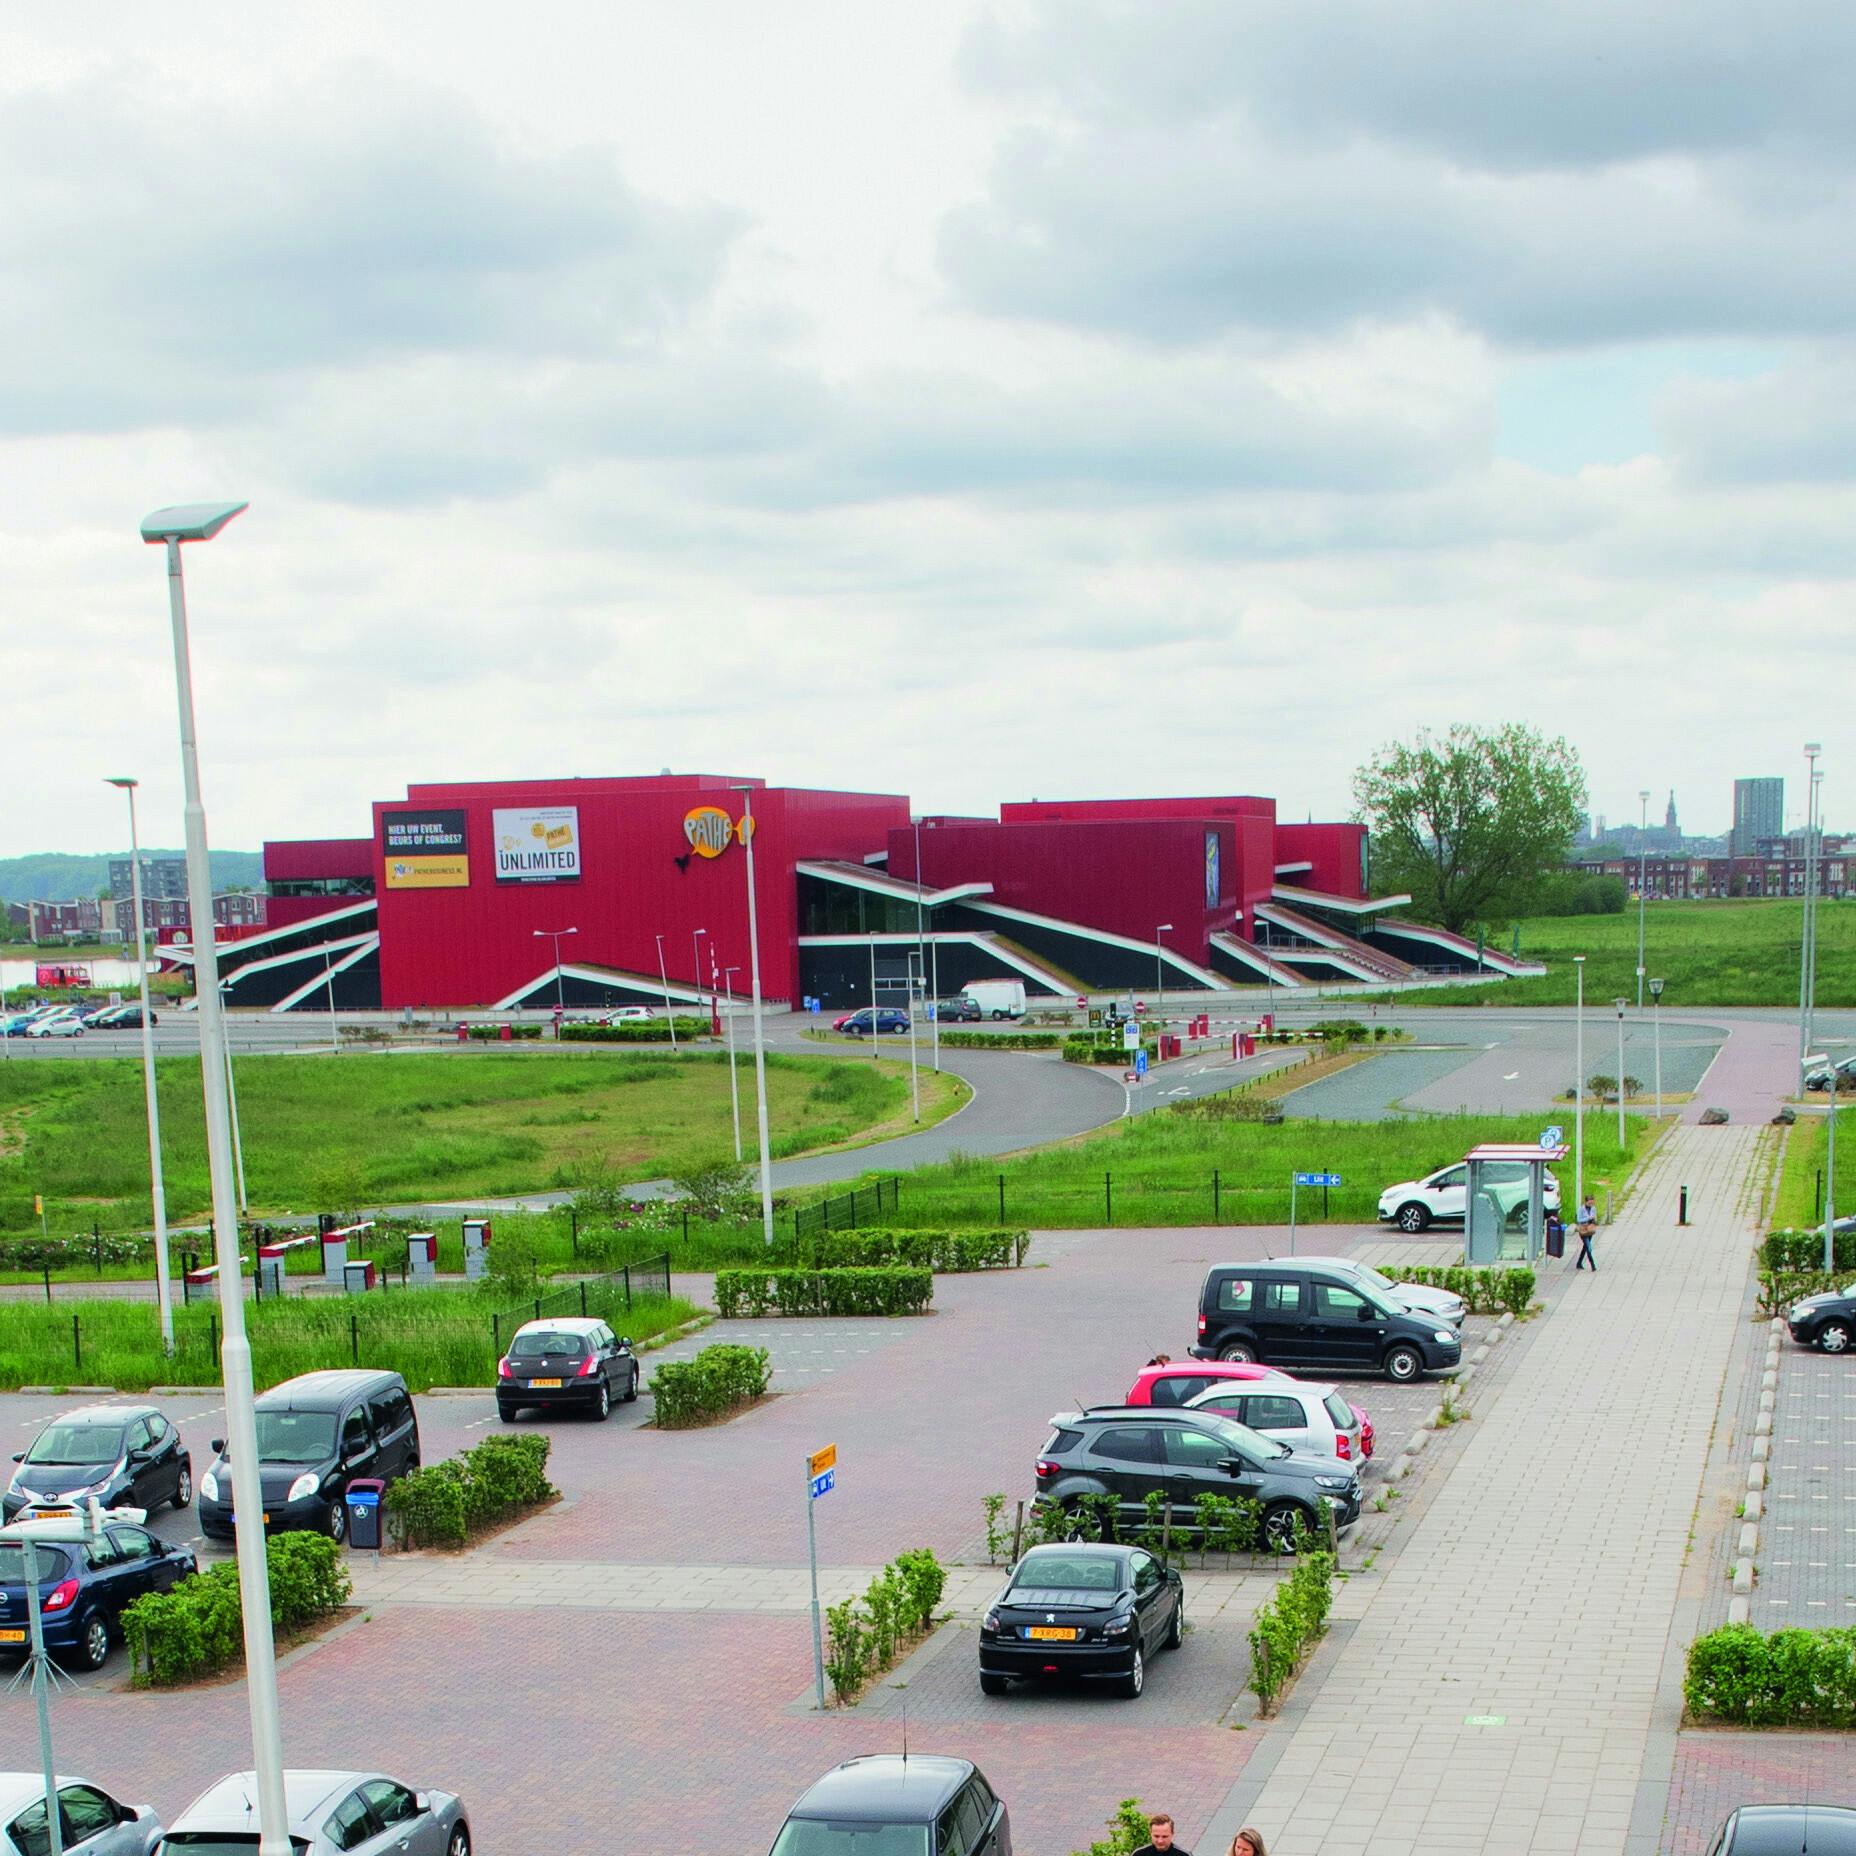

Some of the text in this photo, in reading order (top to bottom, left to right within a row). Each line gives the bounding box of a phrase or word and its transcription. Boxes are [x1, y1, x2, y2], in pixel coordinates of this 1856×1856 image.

[389, 835, 412, 845] BEURS
[425, 834, 463, 844] CONGRES?
[500, 851, 575, 870] UNLIMITED
